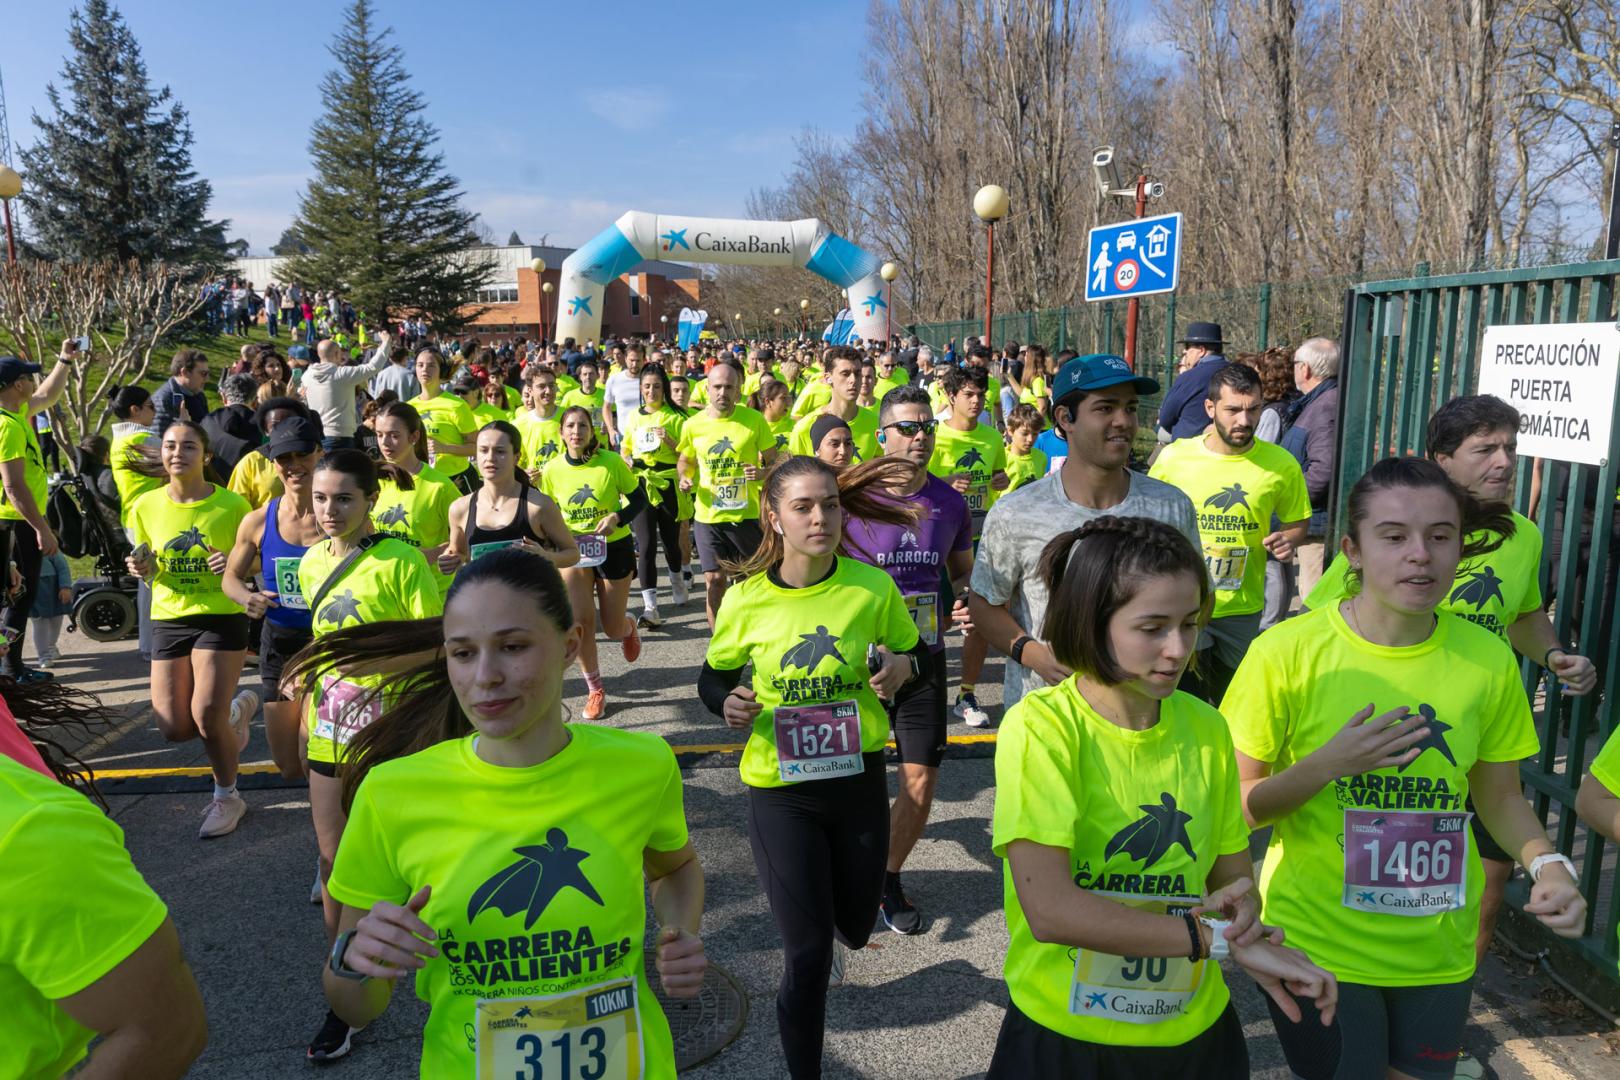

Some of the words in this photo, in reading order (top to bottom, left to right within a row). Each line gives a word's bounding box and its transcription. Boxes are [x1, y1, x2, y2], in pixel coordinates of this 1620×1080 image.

[694, 231, 791, 253] CaixaBank
[1120, 269, 1133, 280] 20
[1495, 338, 1600, 366] PRECAUCIÓN
[1510, 378, 1571, 402] PUERTA
[1519, 410, 1590, 440] OMÁTICA
[718, 485, 738, 498] 357
[1201, 521, 1259, 531] VALIENTES
[877, 550, 938, 565] BARROCO
[836, 704, 854, 716] 5KM
[786, 721, 849, 757] 1521
[803, 759, 855, 773] CaixaBank
[1350, 788, 1459, 810] VALIENTE
[1439, 817, 1462, 831] 5KM
[1076, 860, 1090, 871] LA
[1363, 839, 1452, 882] 1466
[1074, 871, 1186, 893] CARRERA
[1380, 890, 1450, 907] CaixaBank
[438, 928, 454, 940] LA
[441, 926, 594, 963] CARRERA
[467, 937, 631, 986] VALIENTES
[450, 974, 475, 985] LOS
[507, 982, 539, 996] NIÑOS
[591, 989, 628, 1014] 10KM
[515, 1026, 606, 1080] 313
